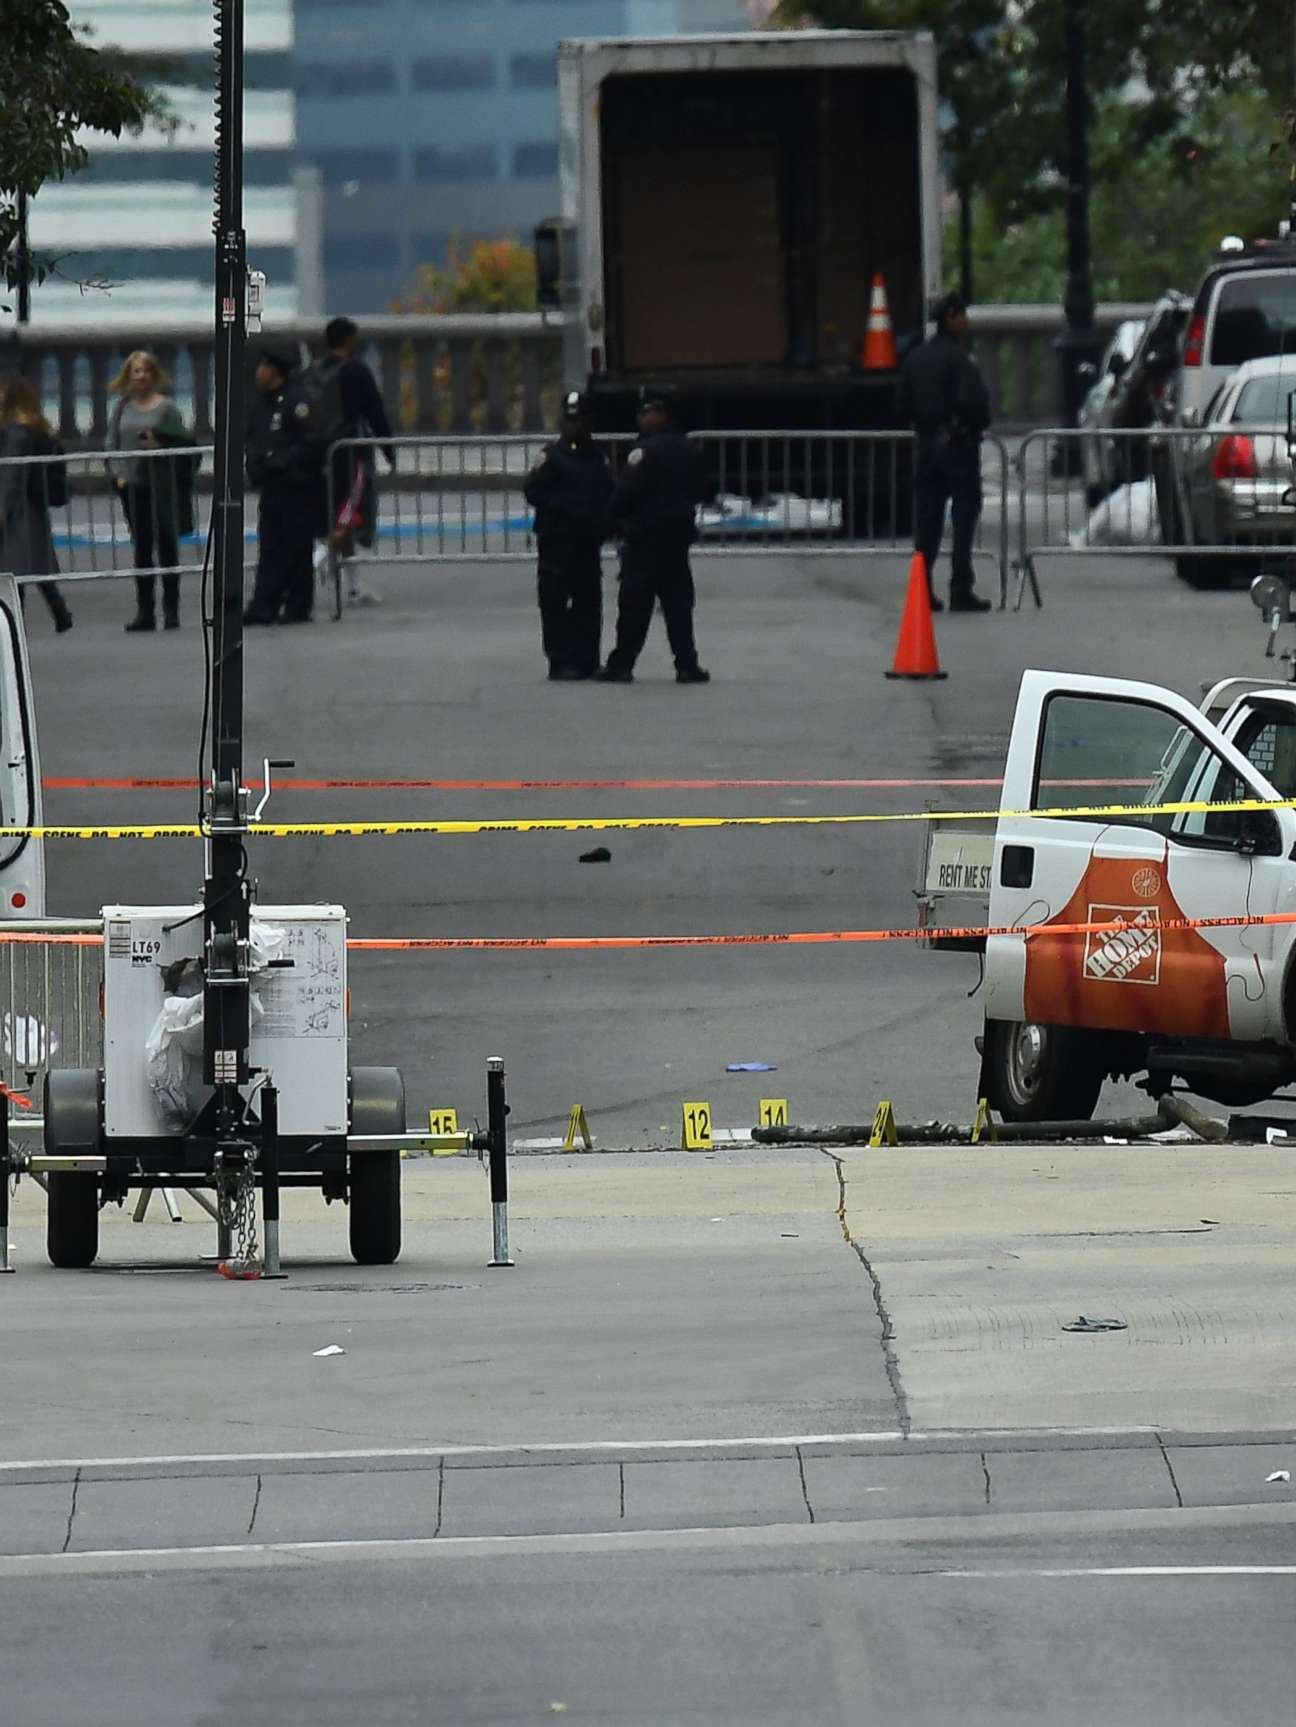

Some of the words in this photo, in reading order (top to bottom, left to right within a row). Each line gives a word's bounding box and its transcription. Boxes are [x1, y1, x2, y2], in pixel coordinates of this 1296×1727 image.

[939, 864, 963, 888] RENT
[965, 865, 979, 888] ME
[980, 865, 992, 889] ST
[132, 941, 161, 954] LT69
[1112, 936, 1158, 978] DEPOT
[131, 955, 153, 963] NYC
[432, 1116, 454, 1135] 15
[688, 1109, 710, 1140] 12
